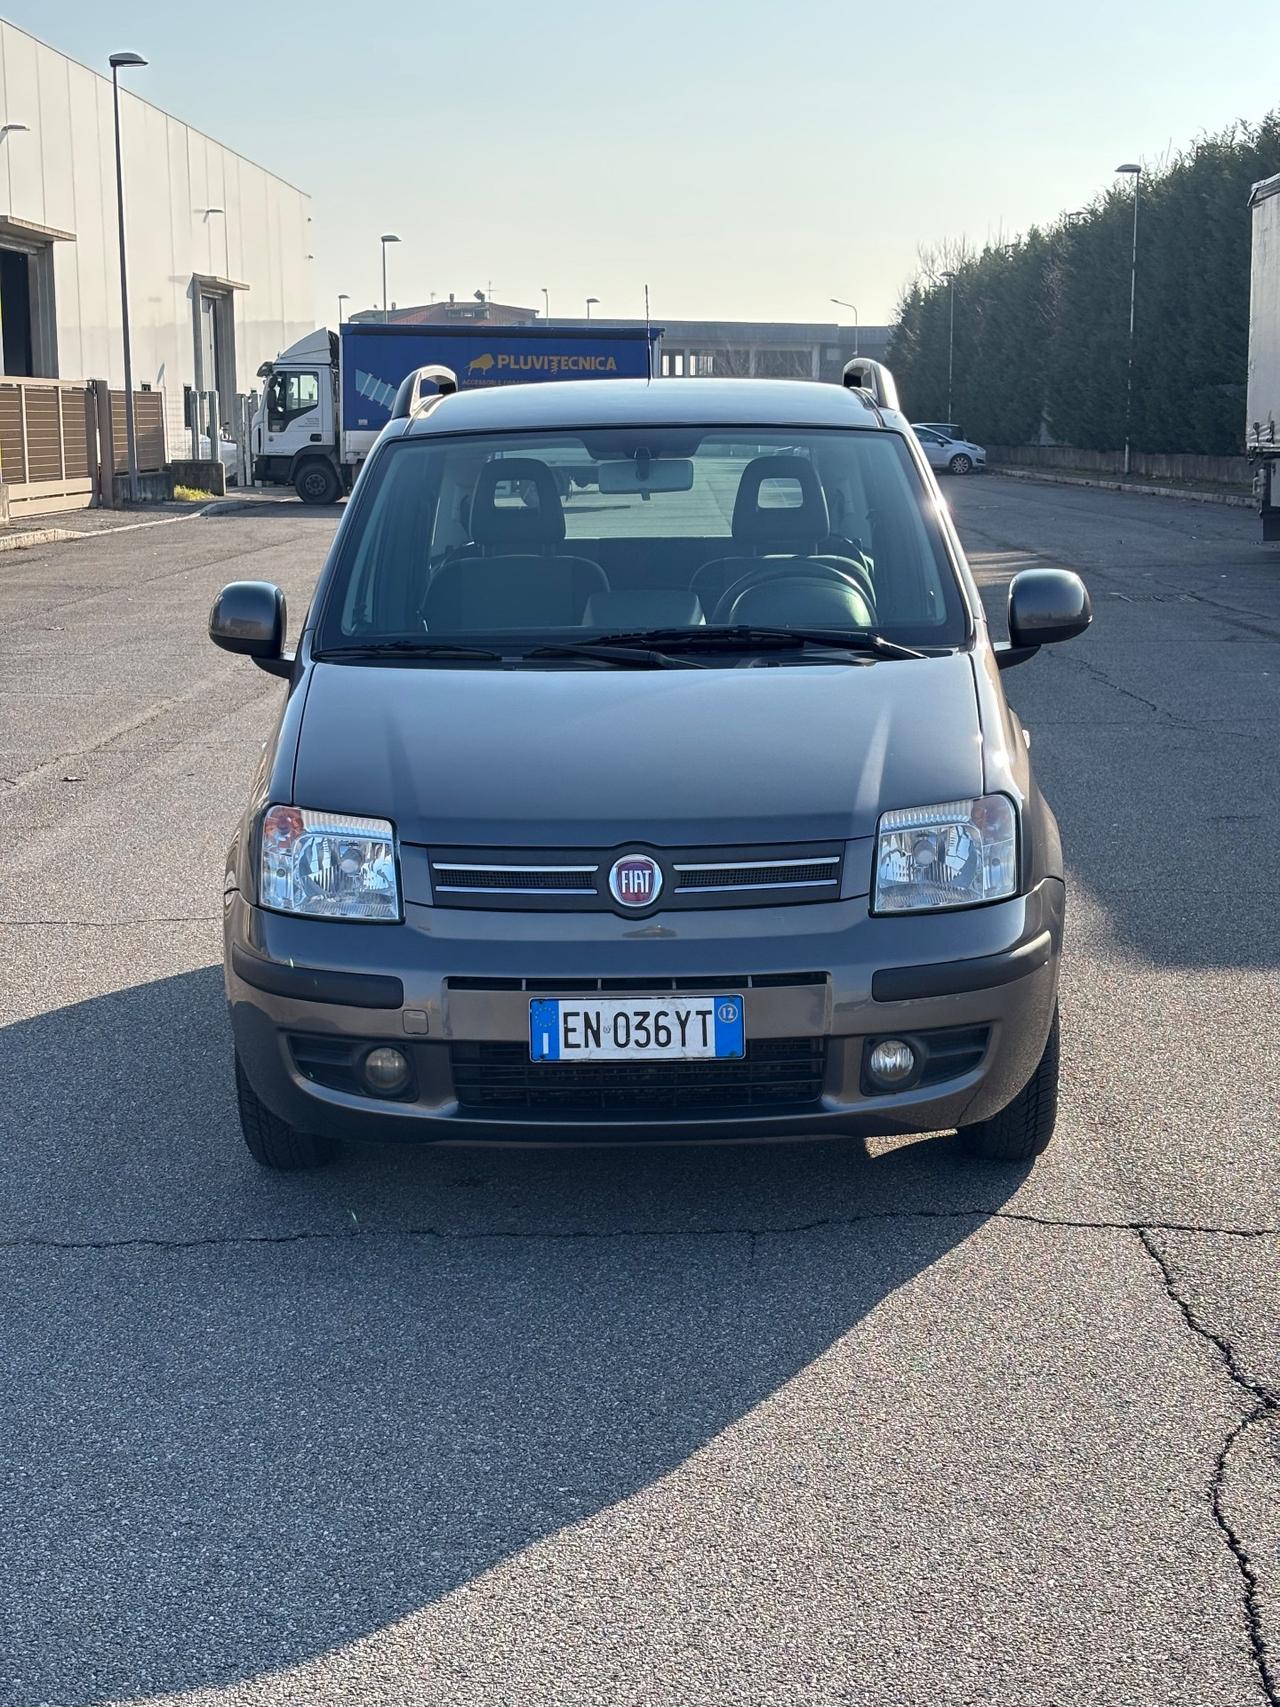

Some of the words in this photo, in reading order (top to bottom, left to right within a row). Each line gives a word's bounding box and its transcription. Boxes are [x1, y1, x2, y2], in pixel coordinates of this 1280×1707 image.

[497, 354, 616, 372] PLUVITECNICA
[621, 870, 652, 894] FIAT
[721, 1006, 735, 1019] 12
[563, 1011, 602, 1048] EN
[613, 1009, 712, 1048] 036YT
